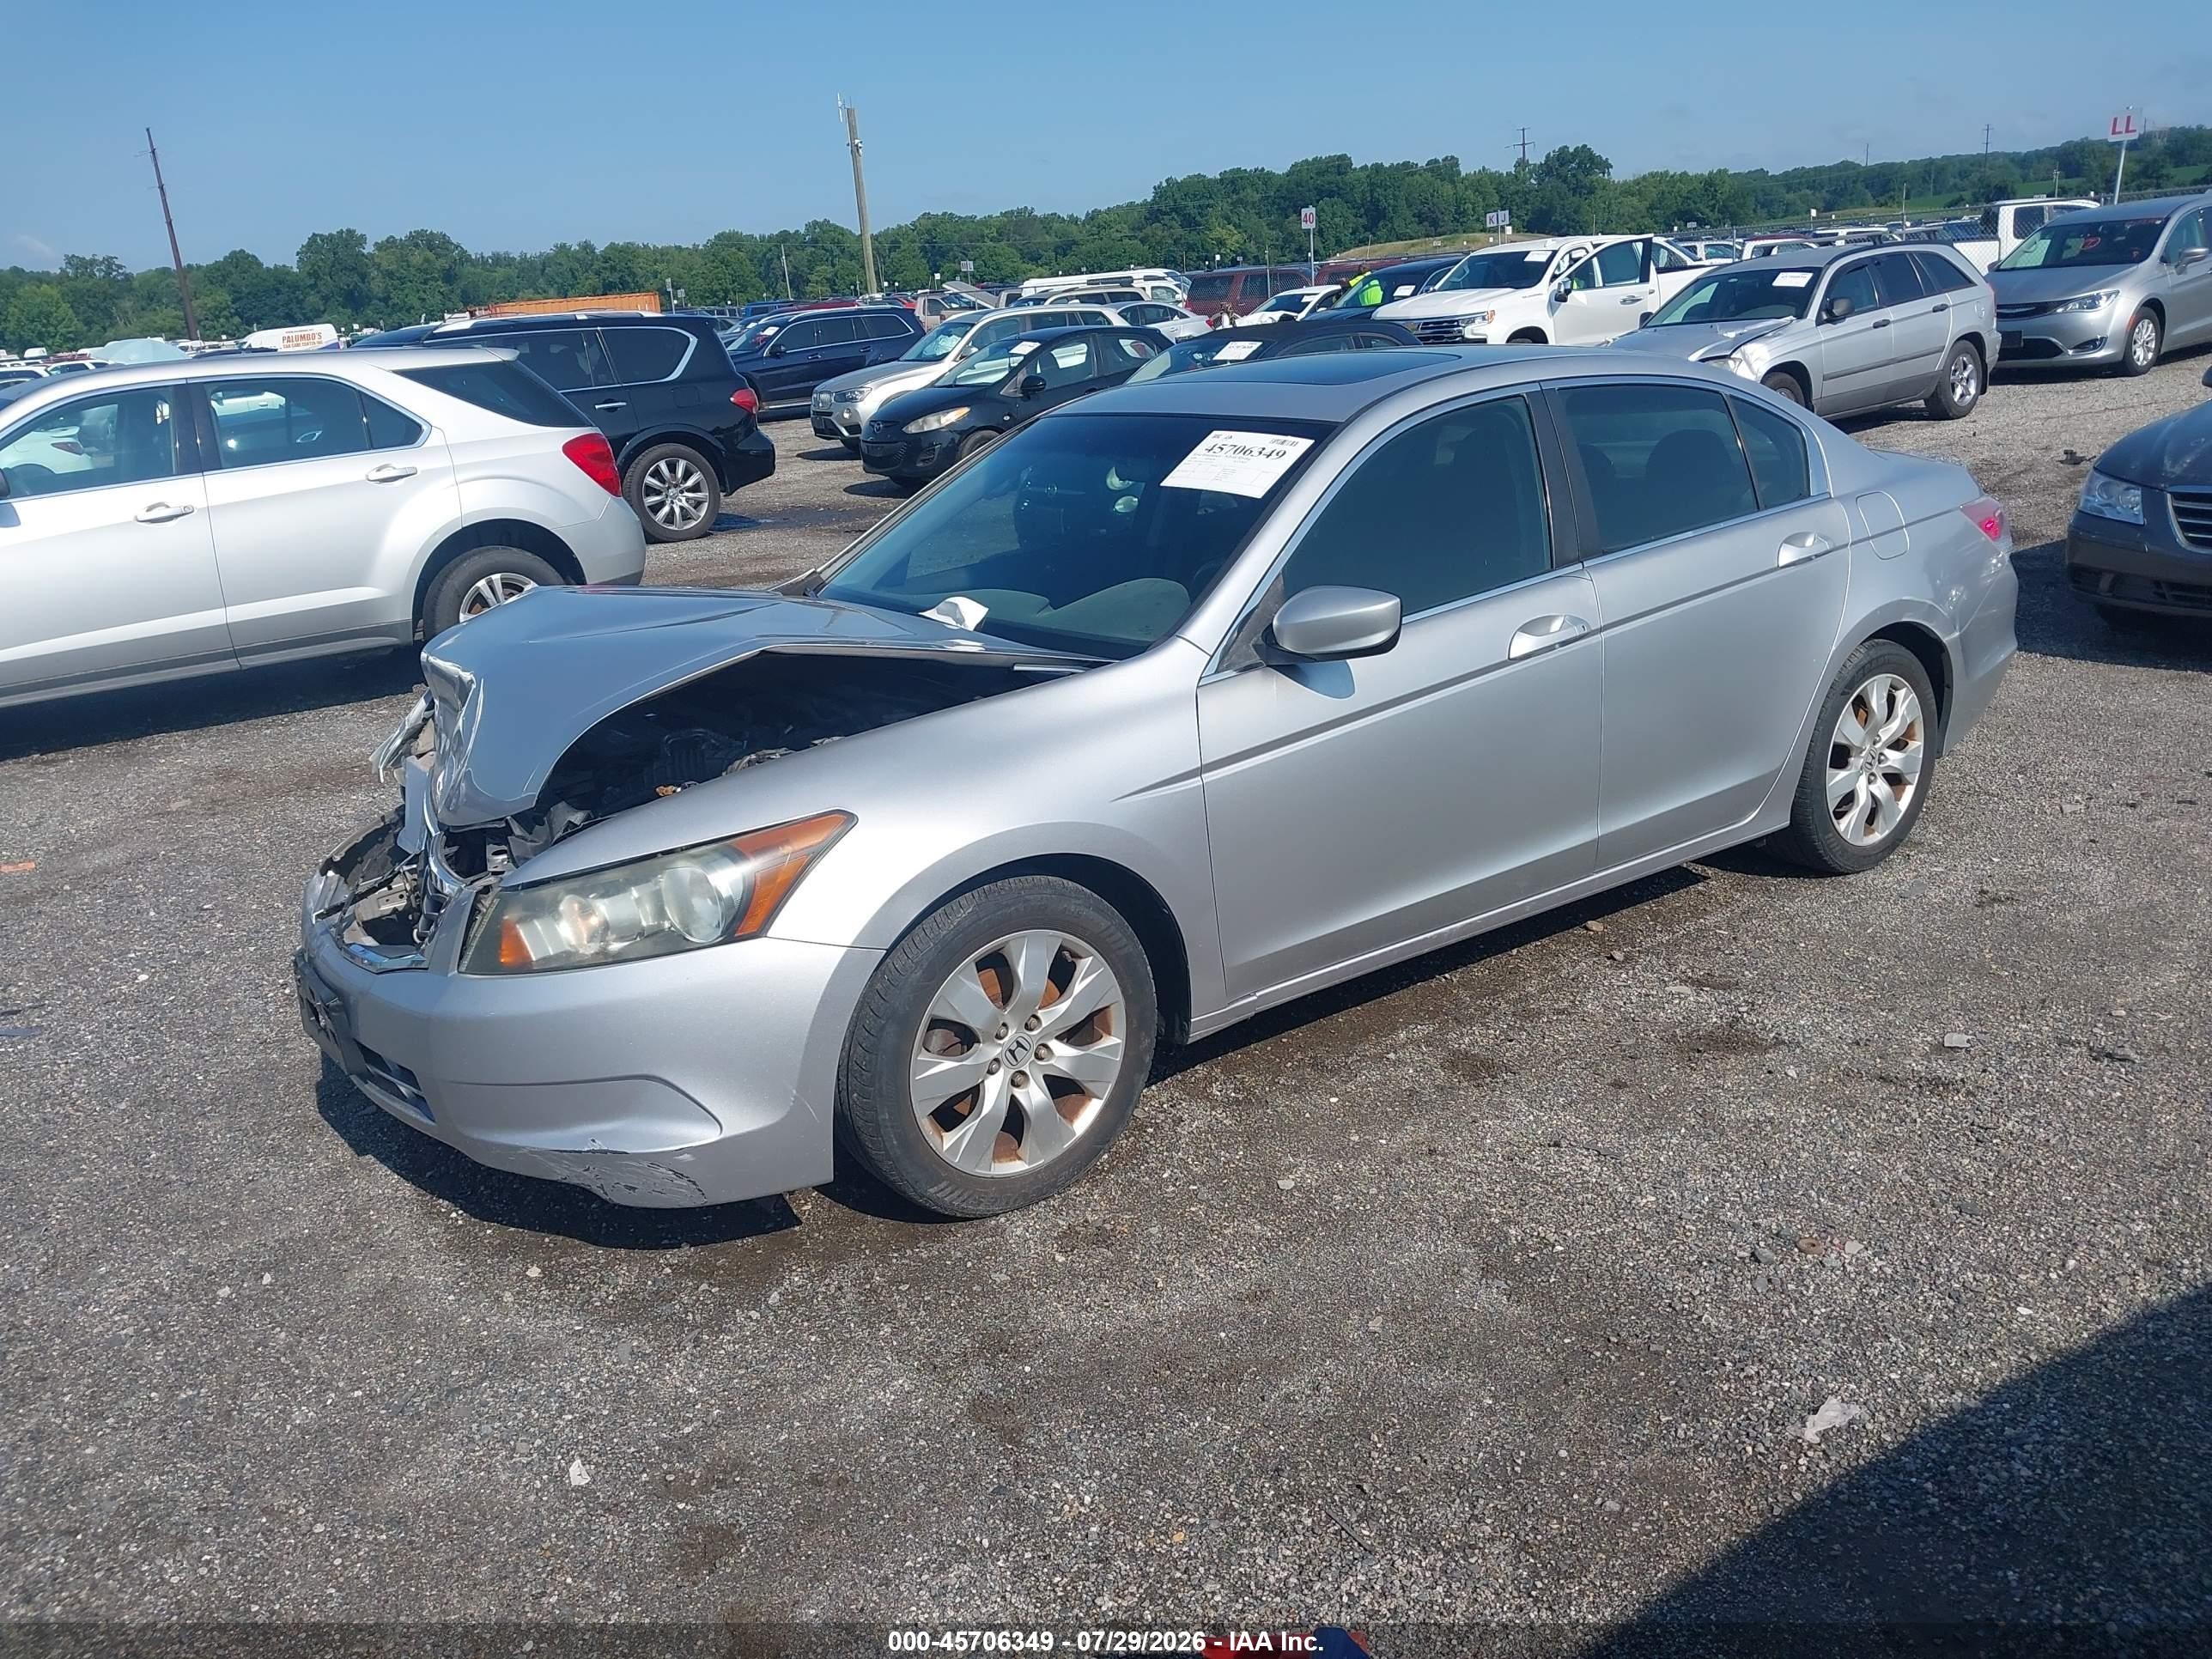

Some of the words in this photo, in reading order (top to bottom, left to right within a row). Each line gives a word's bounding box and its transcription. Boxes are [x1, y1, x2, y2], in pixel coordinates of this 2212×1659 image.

[2112, 115, 2137, 136] LL
[1303, 212, 1314, 224] 40
[1488, 215, 1495, 225] K
[282, 332, 322, 343] PALUMBO'S
[1205, 442, 1287, 460] 45706349
